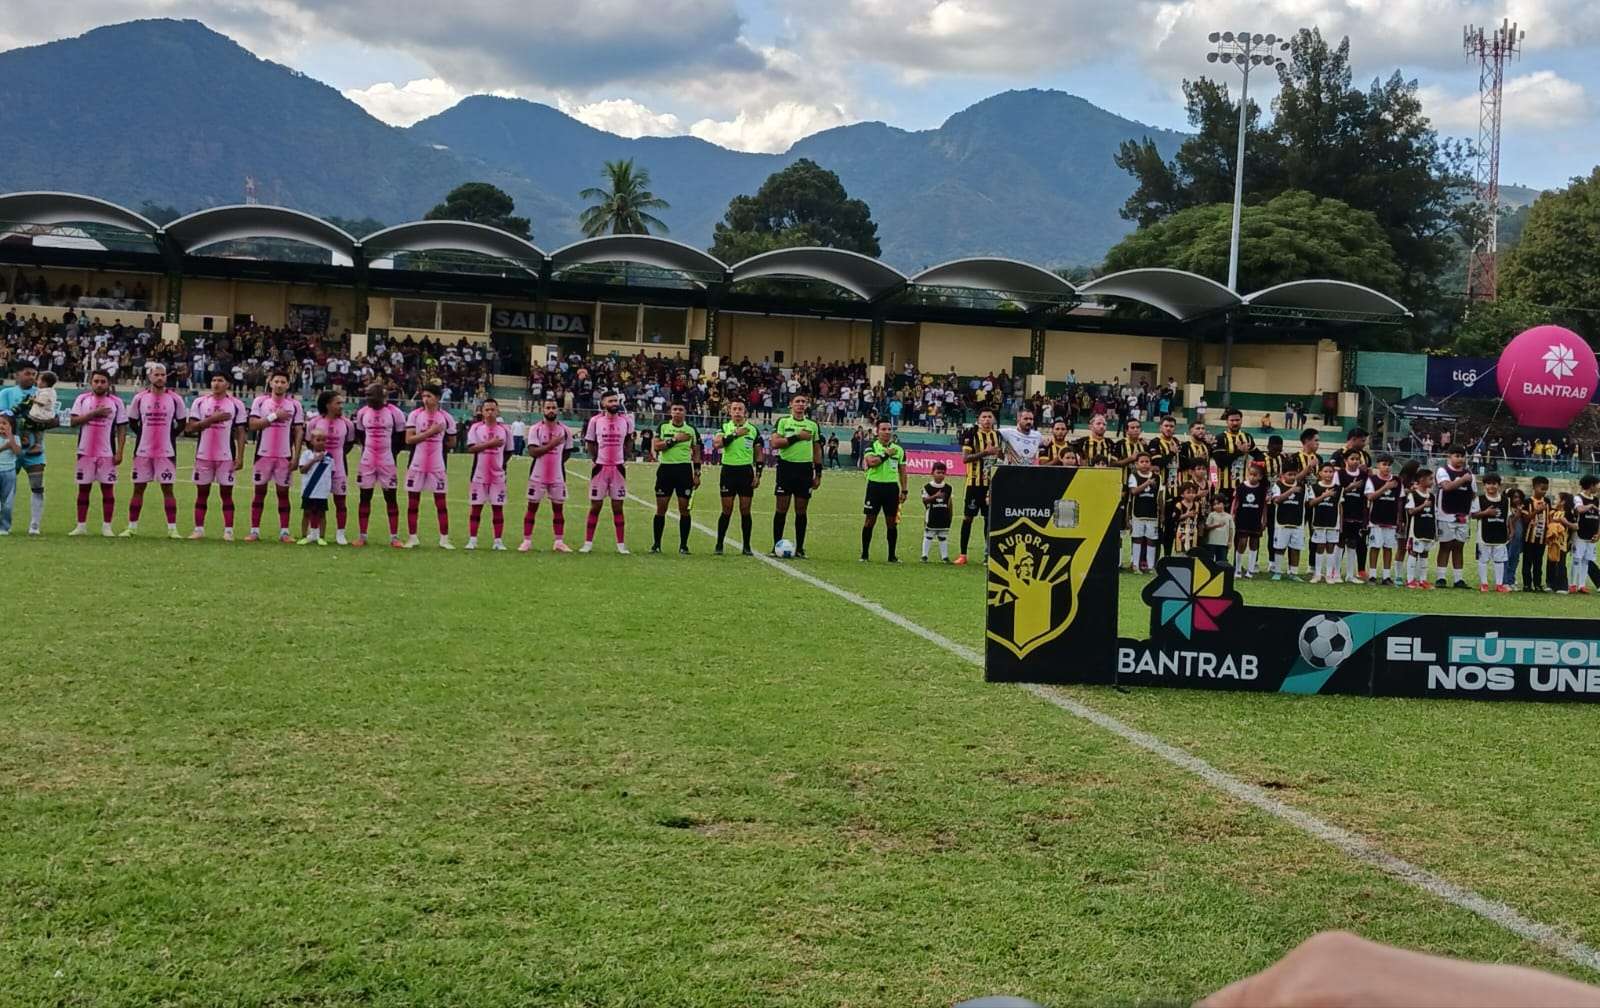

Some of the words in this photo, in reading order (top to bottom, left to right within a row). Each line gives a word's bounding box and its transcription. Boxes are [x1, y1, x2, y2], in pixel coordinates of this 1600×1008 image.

[1523, 382, 1588, 399] BANTRAB
[906, 457, 954, 469] ANTRB
[1005, 507, 1051, 518] BANTRAB
[998, 533, 1050, 553] AURORA
[1386, 636, 1437, 662] EL
[1451, 631, 1600, 666] FÚTBOL
[1118, 647, 1259, 680] BANTRAB
[1428, 665, 1515, 691] NOS
[1529, 667, 1600, 693] UNE
